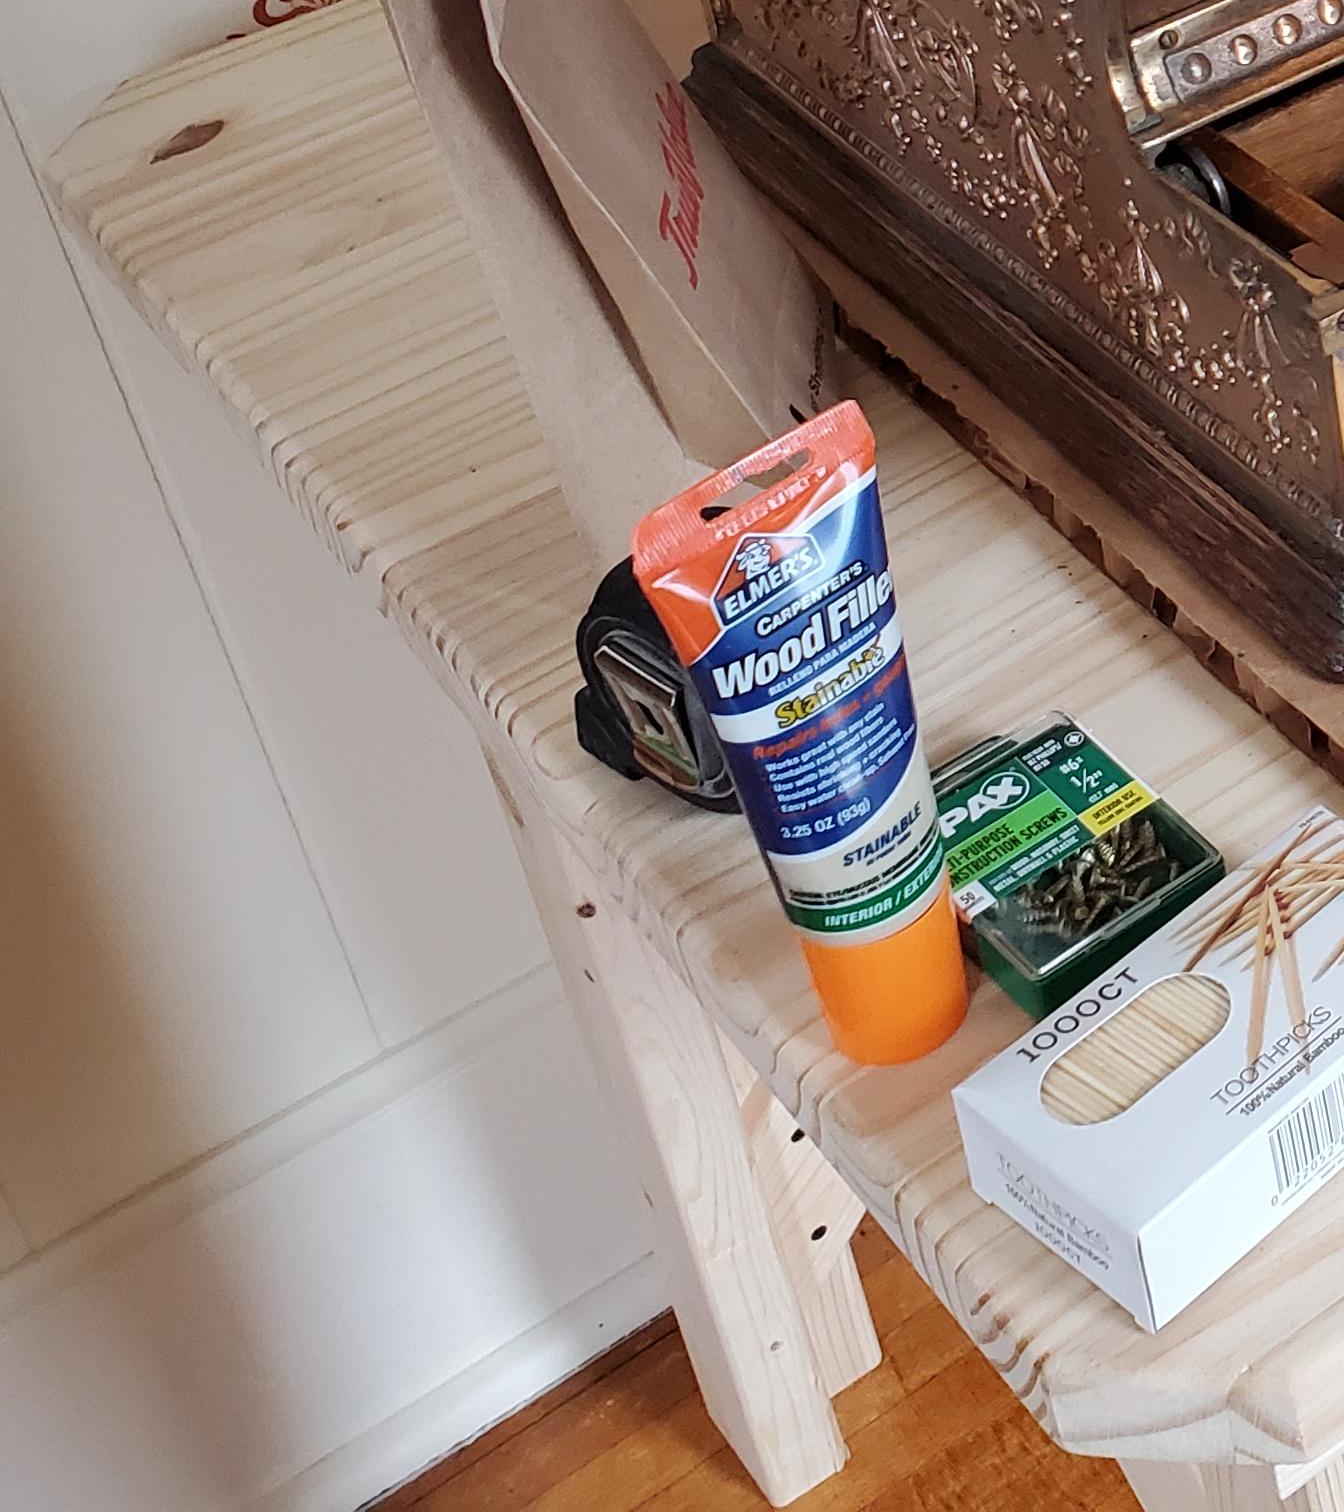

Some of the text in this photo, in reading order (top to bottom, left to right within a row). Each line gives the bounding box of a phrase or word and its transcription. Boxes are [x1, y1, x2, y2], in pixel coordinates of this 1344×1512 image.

[723, 545, 818, 620] ELMER'S
[756, 562, 864, 637] CARPENTER'S
[711, 610, 827, 699] Wood
[829, 569, 894, 640] Fille
[811, 653, 838, 675] PARA
[775, 646, 886, 728] Stainable
[780, 797, 871, 839] 3.25 OZ (93g)
[938, 774, 1024, 838] PAX
[1121, 790, 1136, 801] USE
[843, 801, 922, 866] STAINABLE
[947, 823, 1014, 871] TI-PURPOSE
[949, 835, 1022, 888] NSTRUCTION
[1019, 807, 1068, 840] SCREWS
[824, 896, 893, 927] INTERIOR
[960, 891, 976, 905] 50
[1016, 966, 1138, 1063] 1000CT
[1210, 1006, 1332, 1107] TOOTHPICKS
[1270, 1194, 1279, 1207] 0
